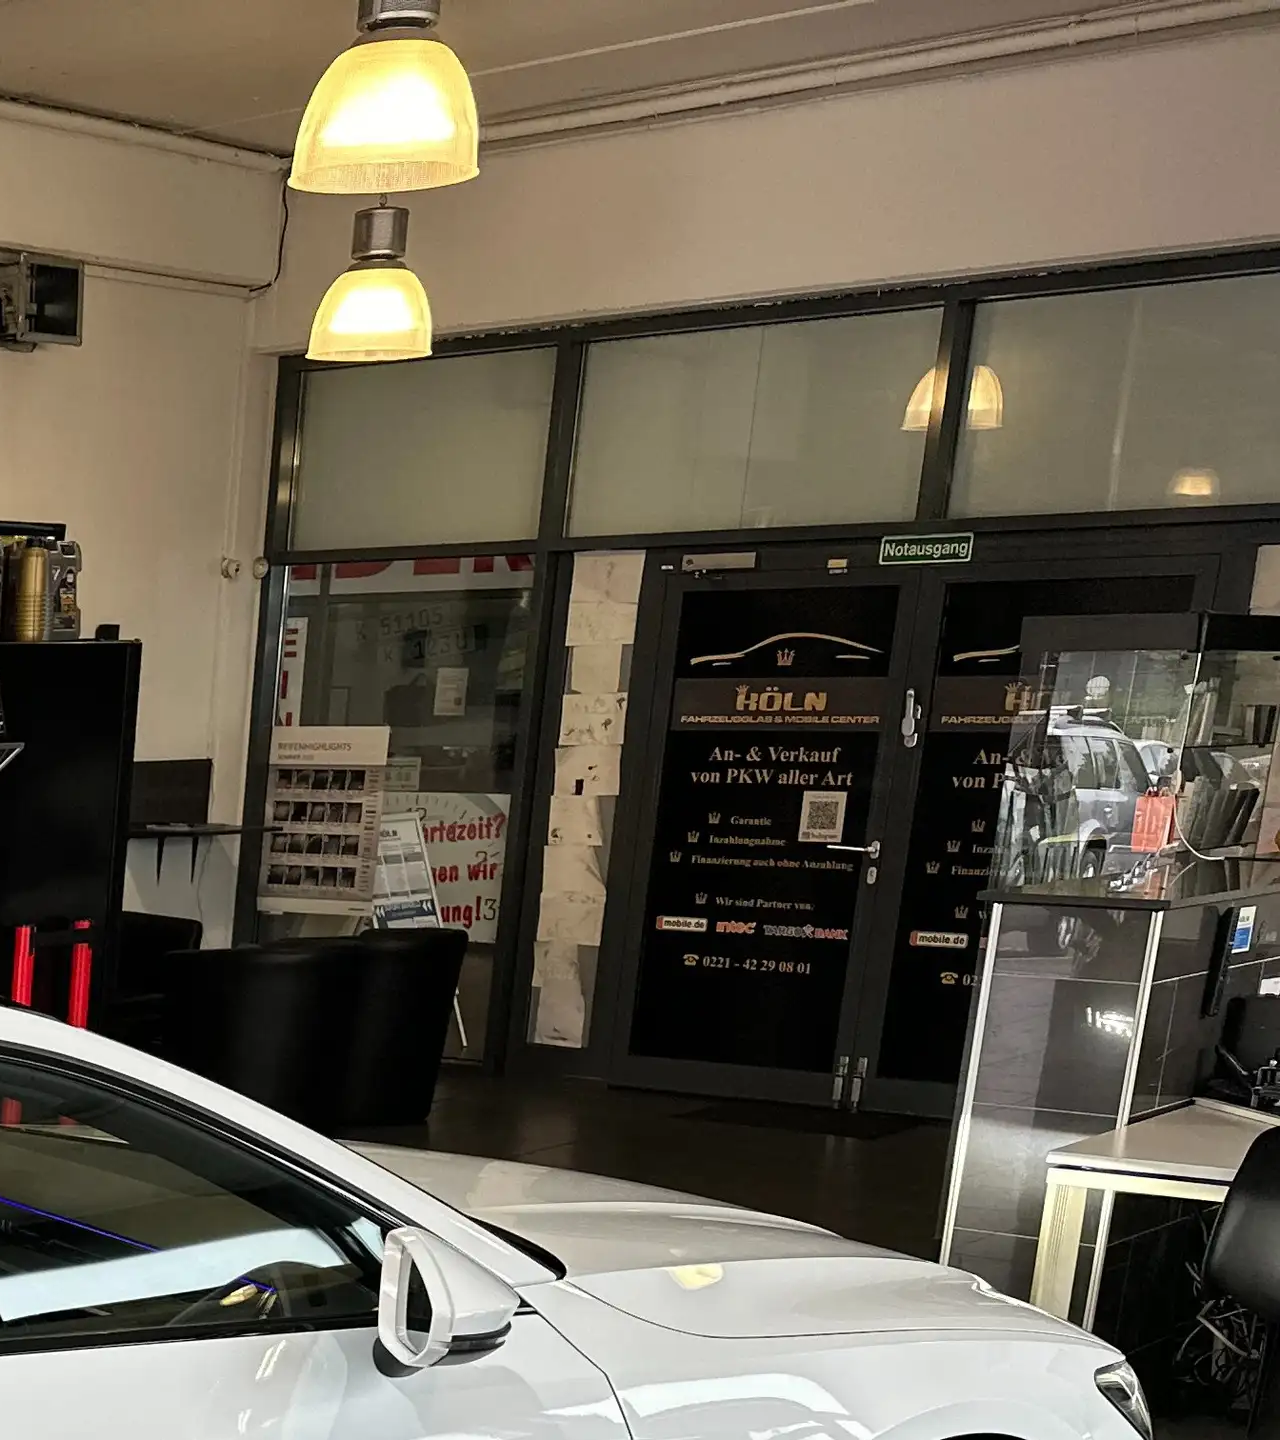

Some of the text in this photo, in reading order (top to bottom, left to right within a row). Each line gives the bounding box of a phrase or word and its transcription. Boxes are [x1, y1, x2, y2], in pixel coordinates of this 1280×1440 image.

[883, 540, 969, 559] Notausgang
[831, 715, 880, 725] CENTER
[708, 746, 842, 764] An- & Verkauf
[690, 768, 854, 786] von PKW aller Art
[952, 775, 985, 789] von
[730, 815, 772, 827] Garantie
[467, 862, 499, 881] wir
[715, 896, 733, 907] Wir
[663, 919, 706, 929] mobile.de
[918, 934, 966, 945] mobile.de
[702, 956, 731, 969] 0221
[743, 957, 757, 970] 42
[760, 959, 776, 972] 29
[779, 960, 793, 973] 08
[796, 961, 811, 974] 01
